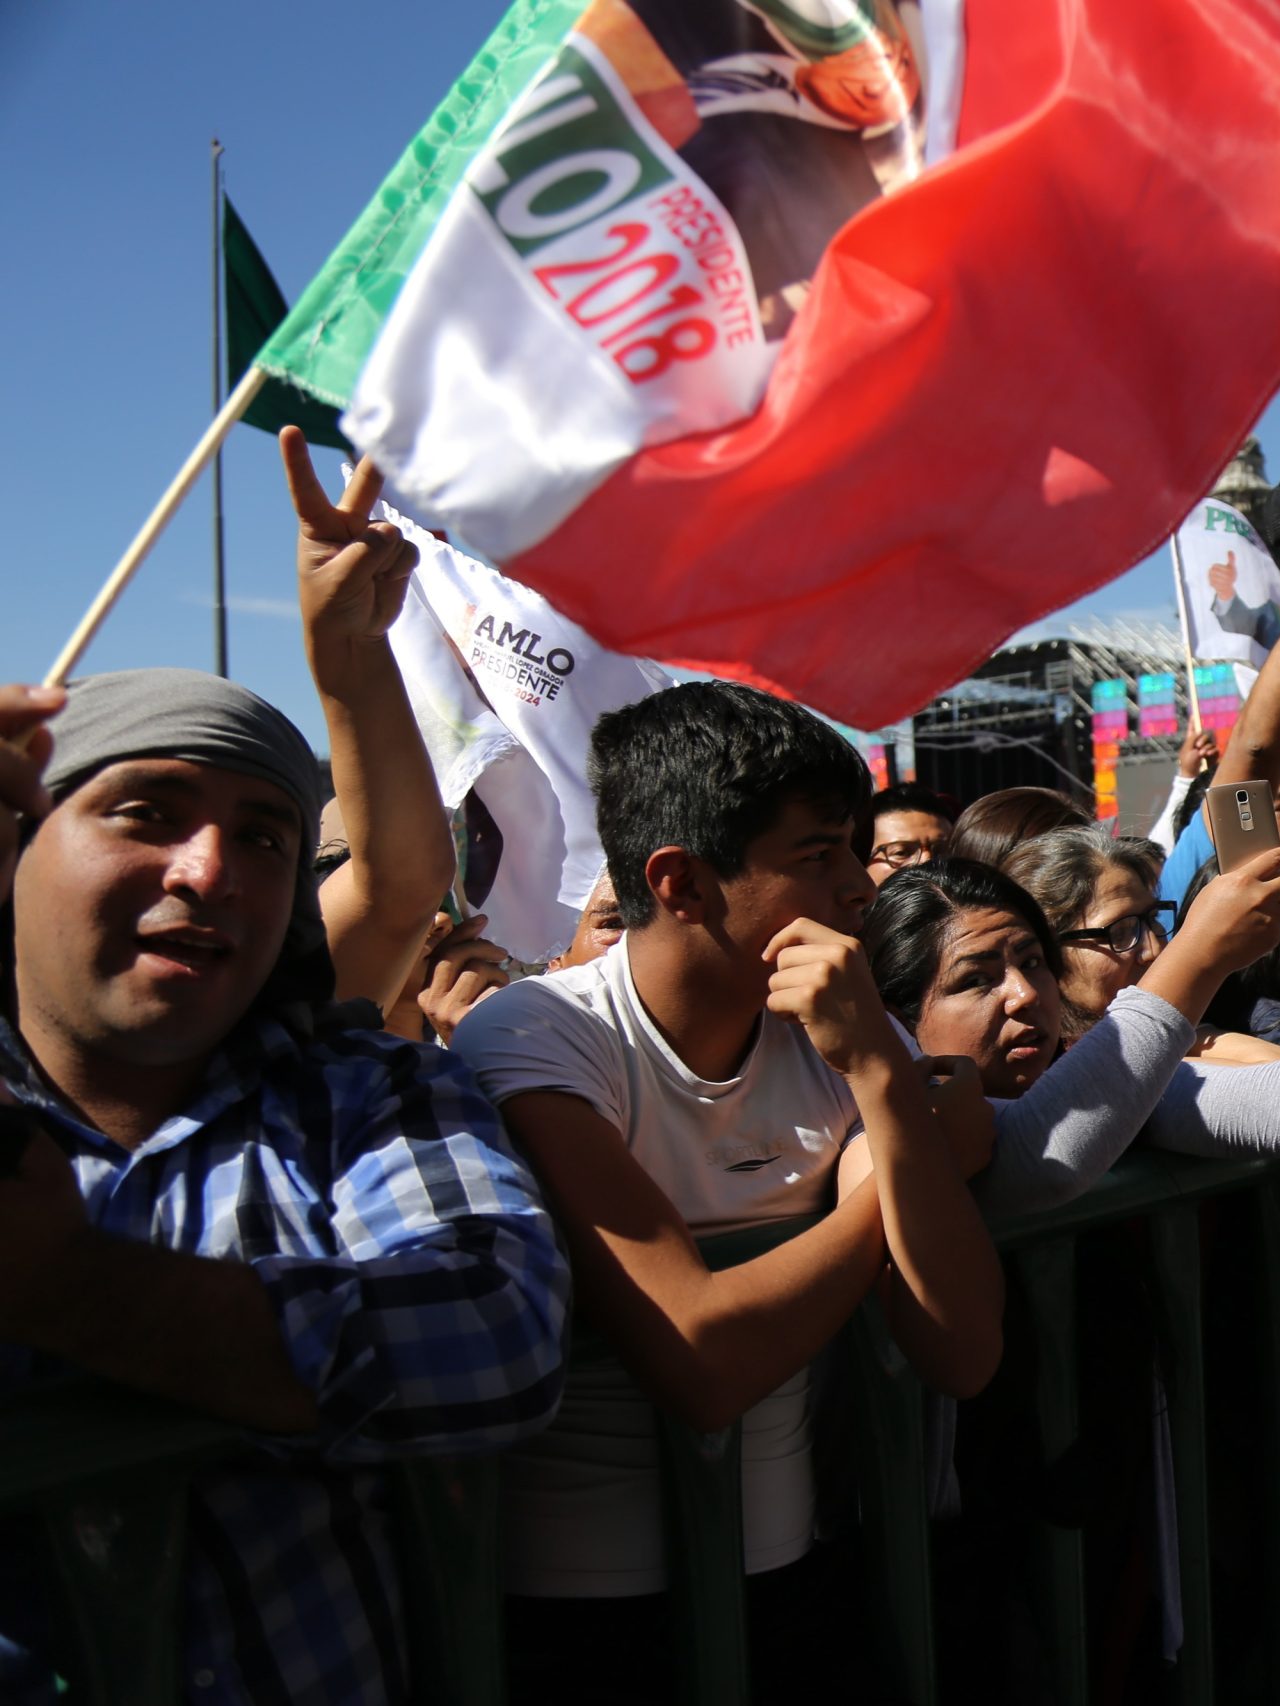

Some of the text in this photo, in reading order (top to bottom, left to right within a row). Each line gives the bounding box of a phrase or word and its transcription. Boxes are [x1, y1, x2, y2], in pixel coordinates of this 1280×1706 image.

[532, 222, 718, 385] 2018
[650, 184, 754, 351] PRESIDENTE
[471, 647, 560, 702] PRESIDENTE
[474, 614, 575, 677] AMLO
